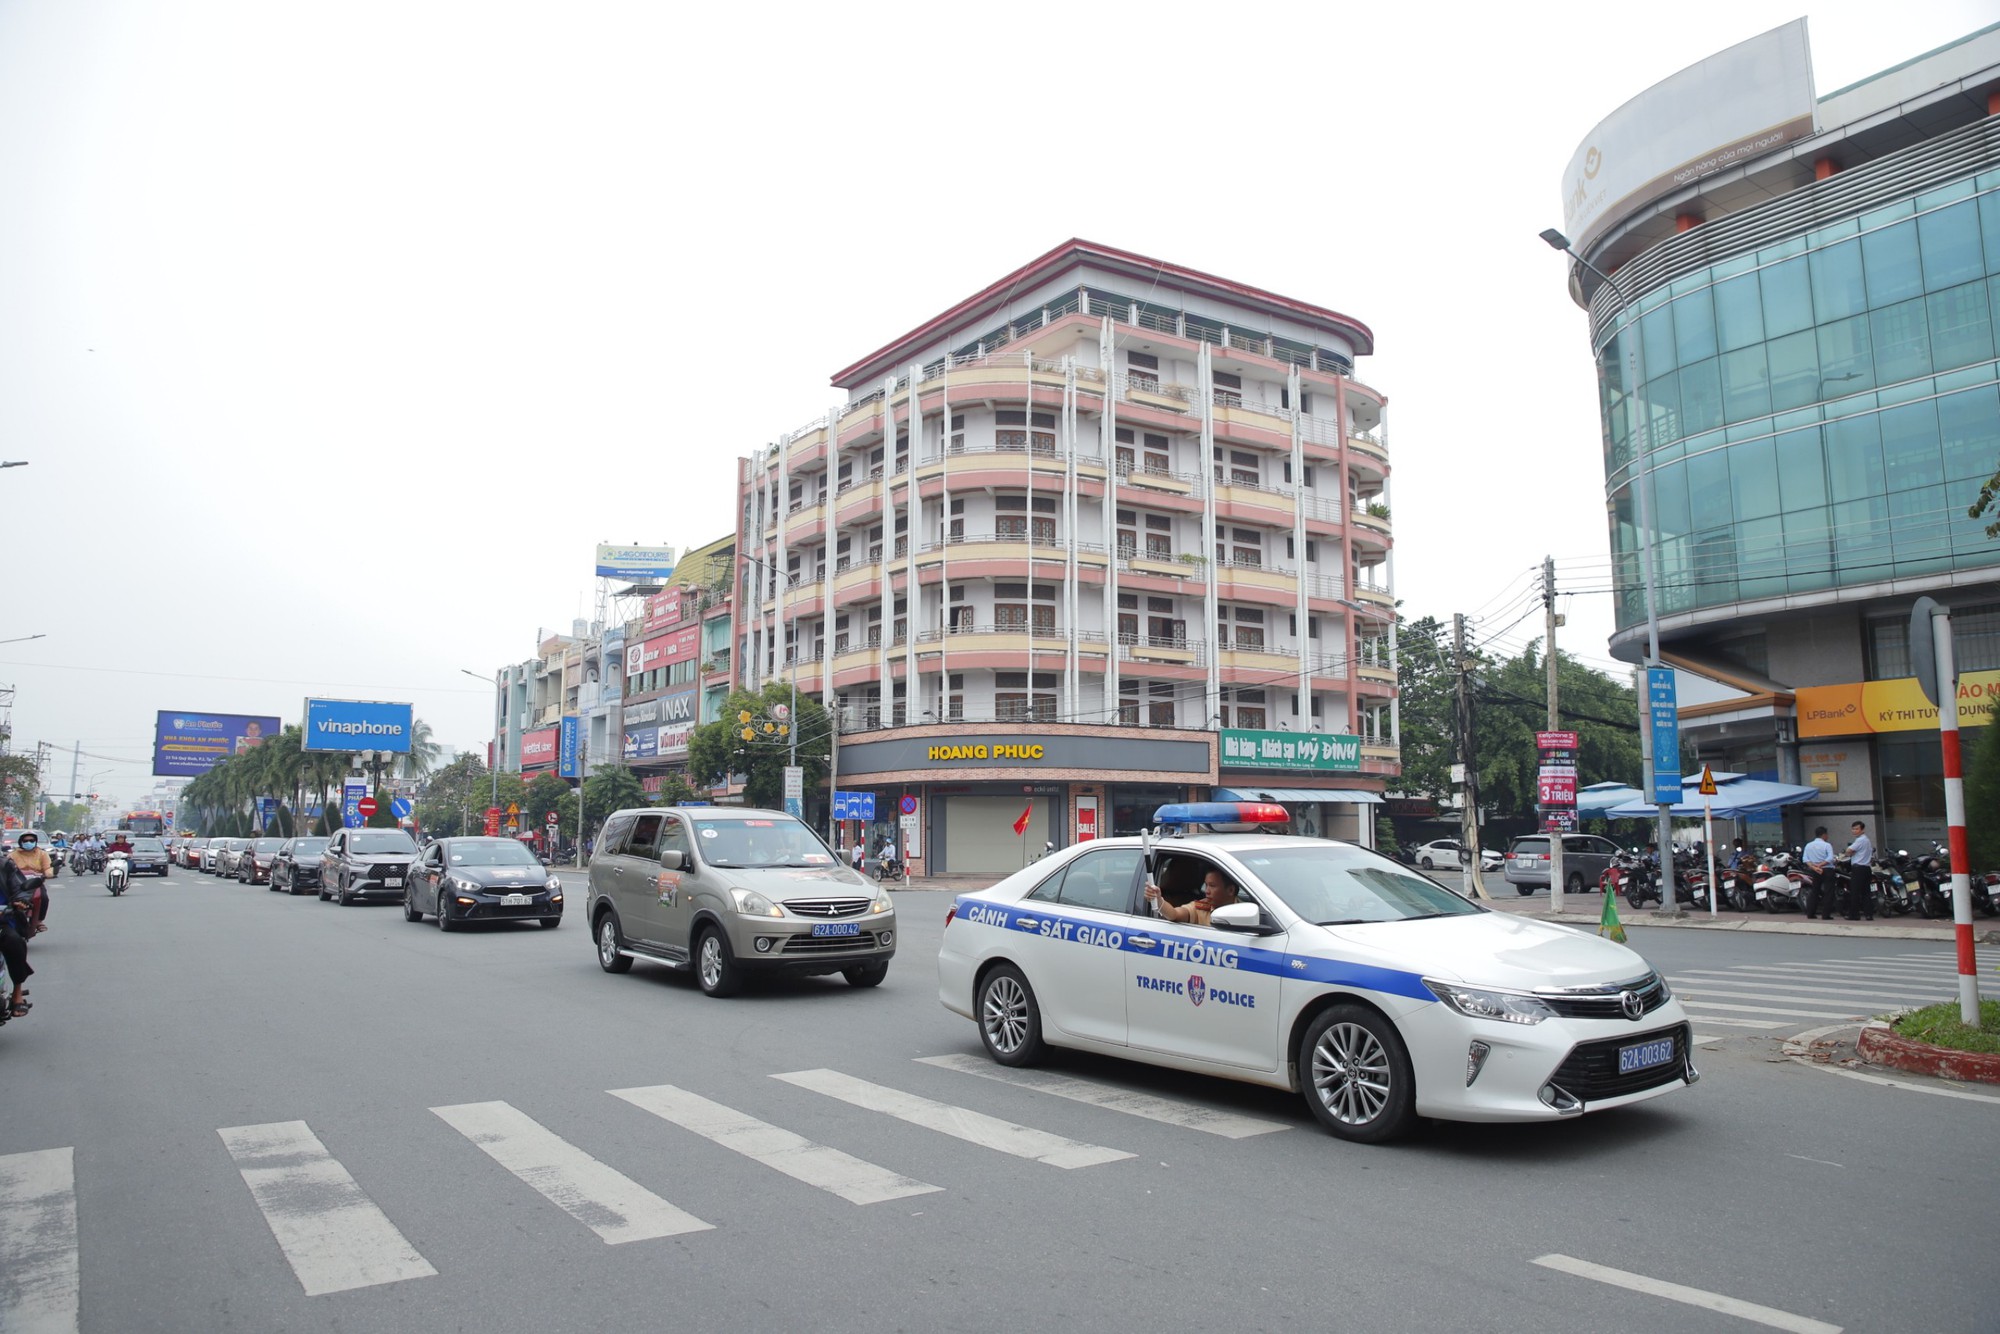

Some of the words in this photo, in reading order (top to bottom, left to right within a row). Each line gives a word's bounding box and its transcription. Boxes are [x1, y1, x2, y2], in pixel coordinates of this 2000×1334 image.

[1673, 168, 1695, 182] Ngân
[1695, 157, 1717, 171] hàng
[1718, 151, 1736, 163] của
[1736, 144, 1754, 156] mọi
[1755, 132, 1784, 149] người!
[661, 696, 690, 722] INAX
[1806, 708, 1846, 721] LPBank
[1896, 711, 1915, 720] THI
[317, 718, 403, 736] vinaphone
[928, 745, 988, 761] HOANG
[993, 744, 1045, 759] PHUC
[1225, 736, 1239, 757] Nhà
[1240, 737, 1256, 760] hàng
[1261, 738, 1282, 759] Khách
[1283, 742, 1296, 762] sạn
[1297, 737, 1319, 762] MỸ
[1321, 736, 1357, 762] ĐÌNH
[1541, 785, 1550, 801] 3
[1551, 787, 1574, 803] TRIỆU
[1656, 783, 1681, 792] vinaphone
[1078, 823, 1095, 834] SALE
[968, 904, 1008, 928] CẢNH
[1039, 917, 1073, 940] SÁT
[1076, 926, 1122, 950] GIAO
[1160, 939, 1239, 969] THÔNG
[1136, 975, 1183, 995] TRAFFIC
[1209, 988, 1255, 1008] POLICE
[1620, 1040, 1672, 1071] 62A-003.62
